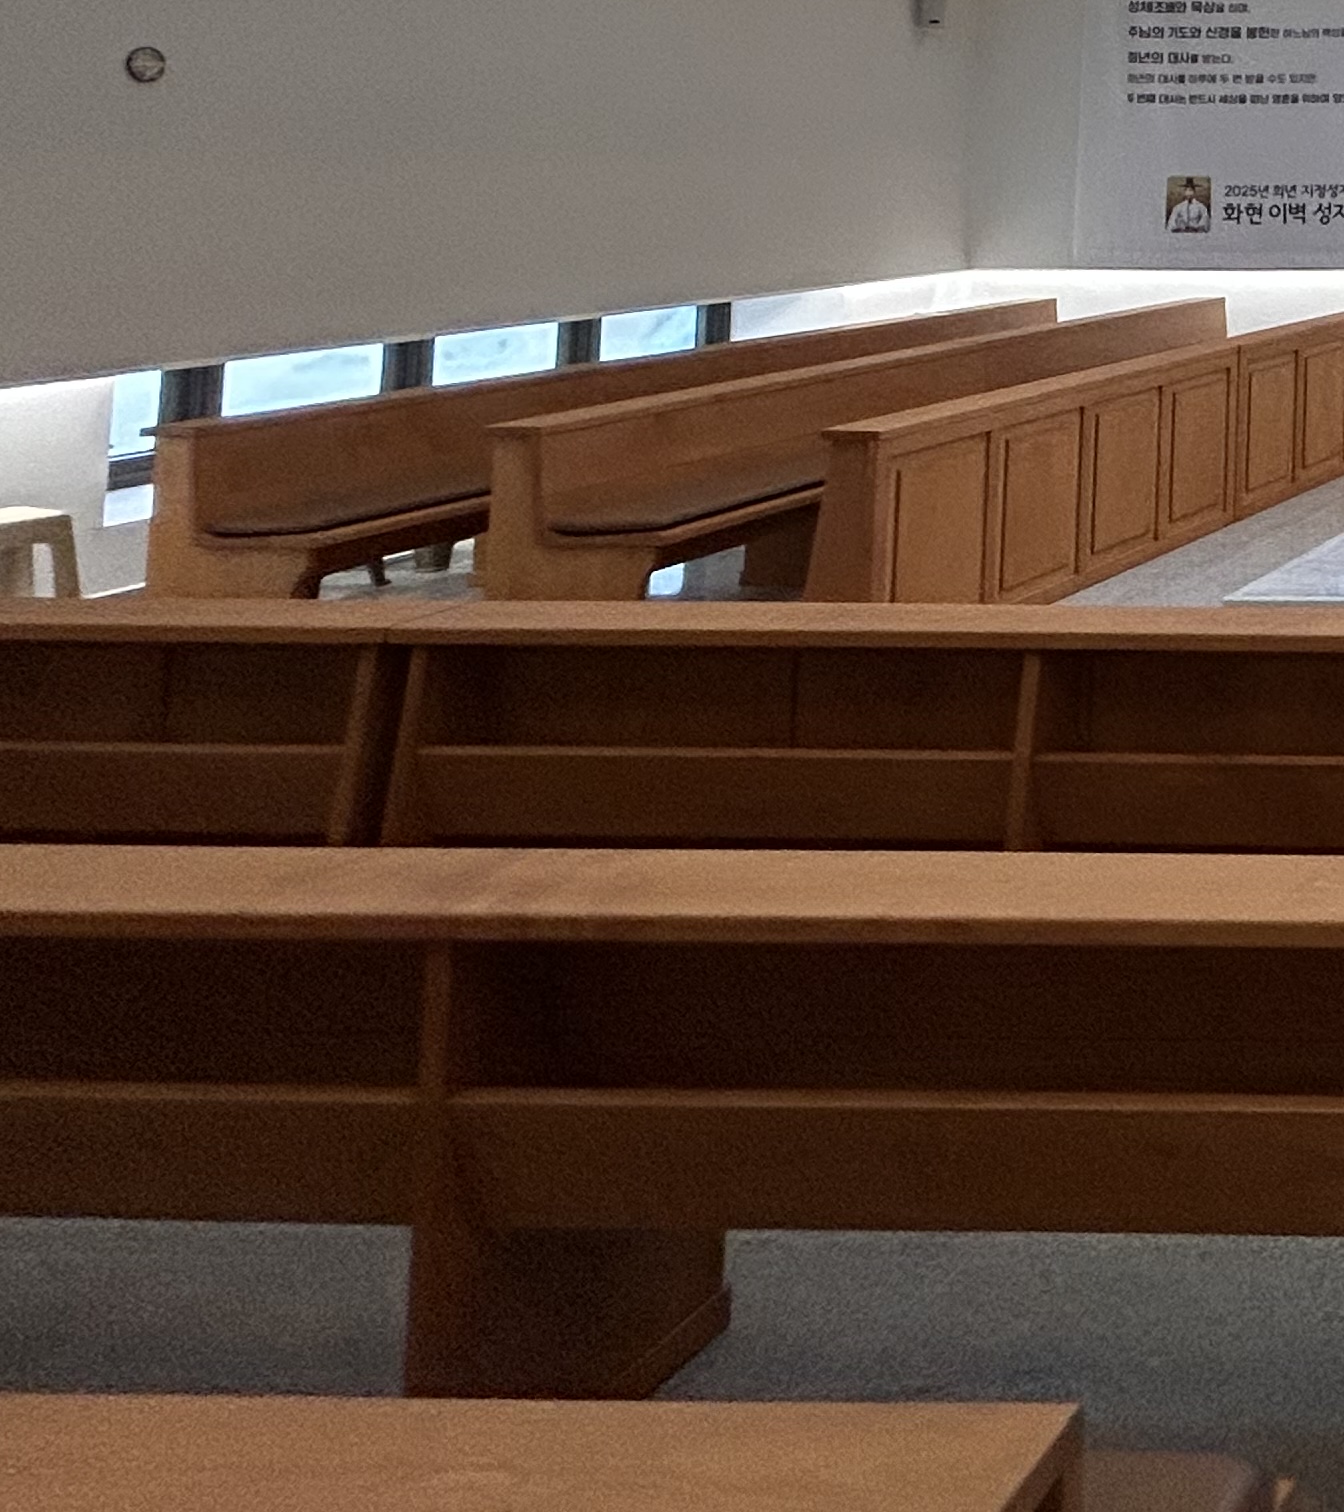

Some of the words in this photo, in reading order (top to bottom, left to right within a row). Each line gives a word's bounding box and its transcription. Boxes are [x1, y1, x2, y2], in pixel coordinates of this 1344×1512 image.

[1128, 26, 1165, 40] 주님의
[1167, 26, 1202, 40] 기도와
[1205, 26, 1242, 40] 신경을
[1224, 184, 1270, 199] 2025년
[1272, 184, 1298, 199] 희년
[1221, 202, 1264, 226] 화현
[1268, 202, 1307, 226] 이벽
